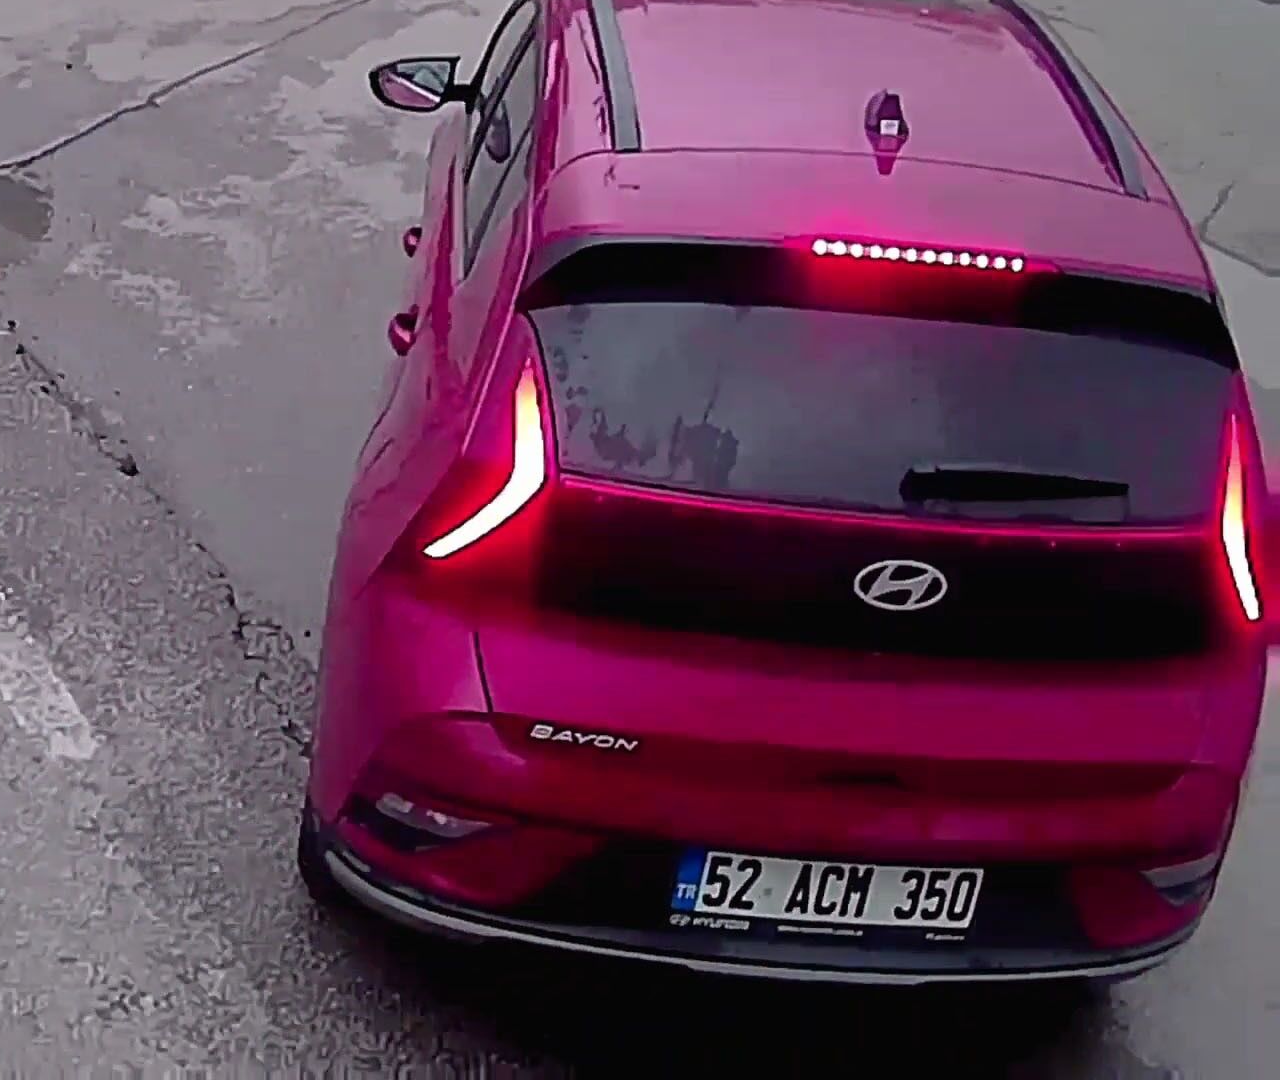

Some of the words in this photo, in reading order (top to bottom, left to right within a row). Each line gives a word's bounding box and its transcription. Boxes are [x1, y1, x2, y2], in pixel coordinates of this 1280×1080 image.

[530, 724, 638, 751] BAYON
[676, 883, 696, 899] TR
[702, 856, 762, 910] 52
[785, 863, 875, 918] ACM
[893, 870, 977, 922] 350
